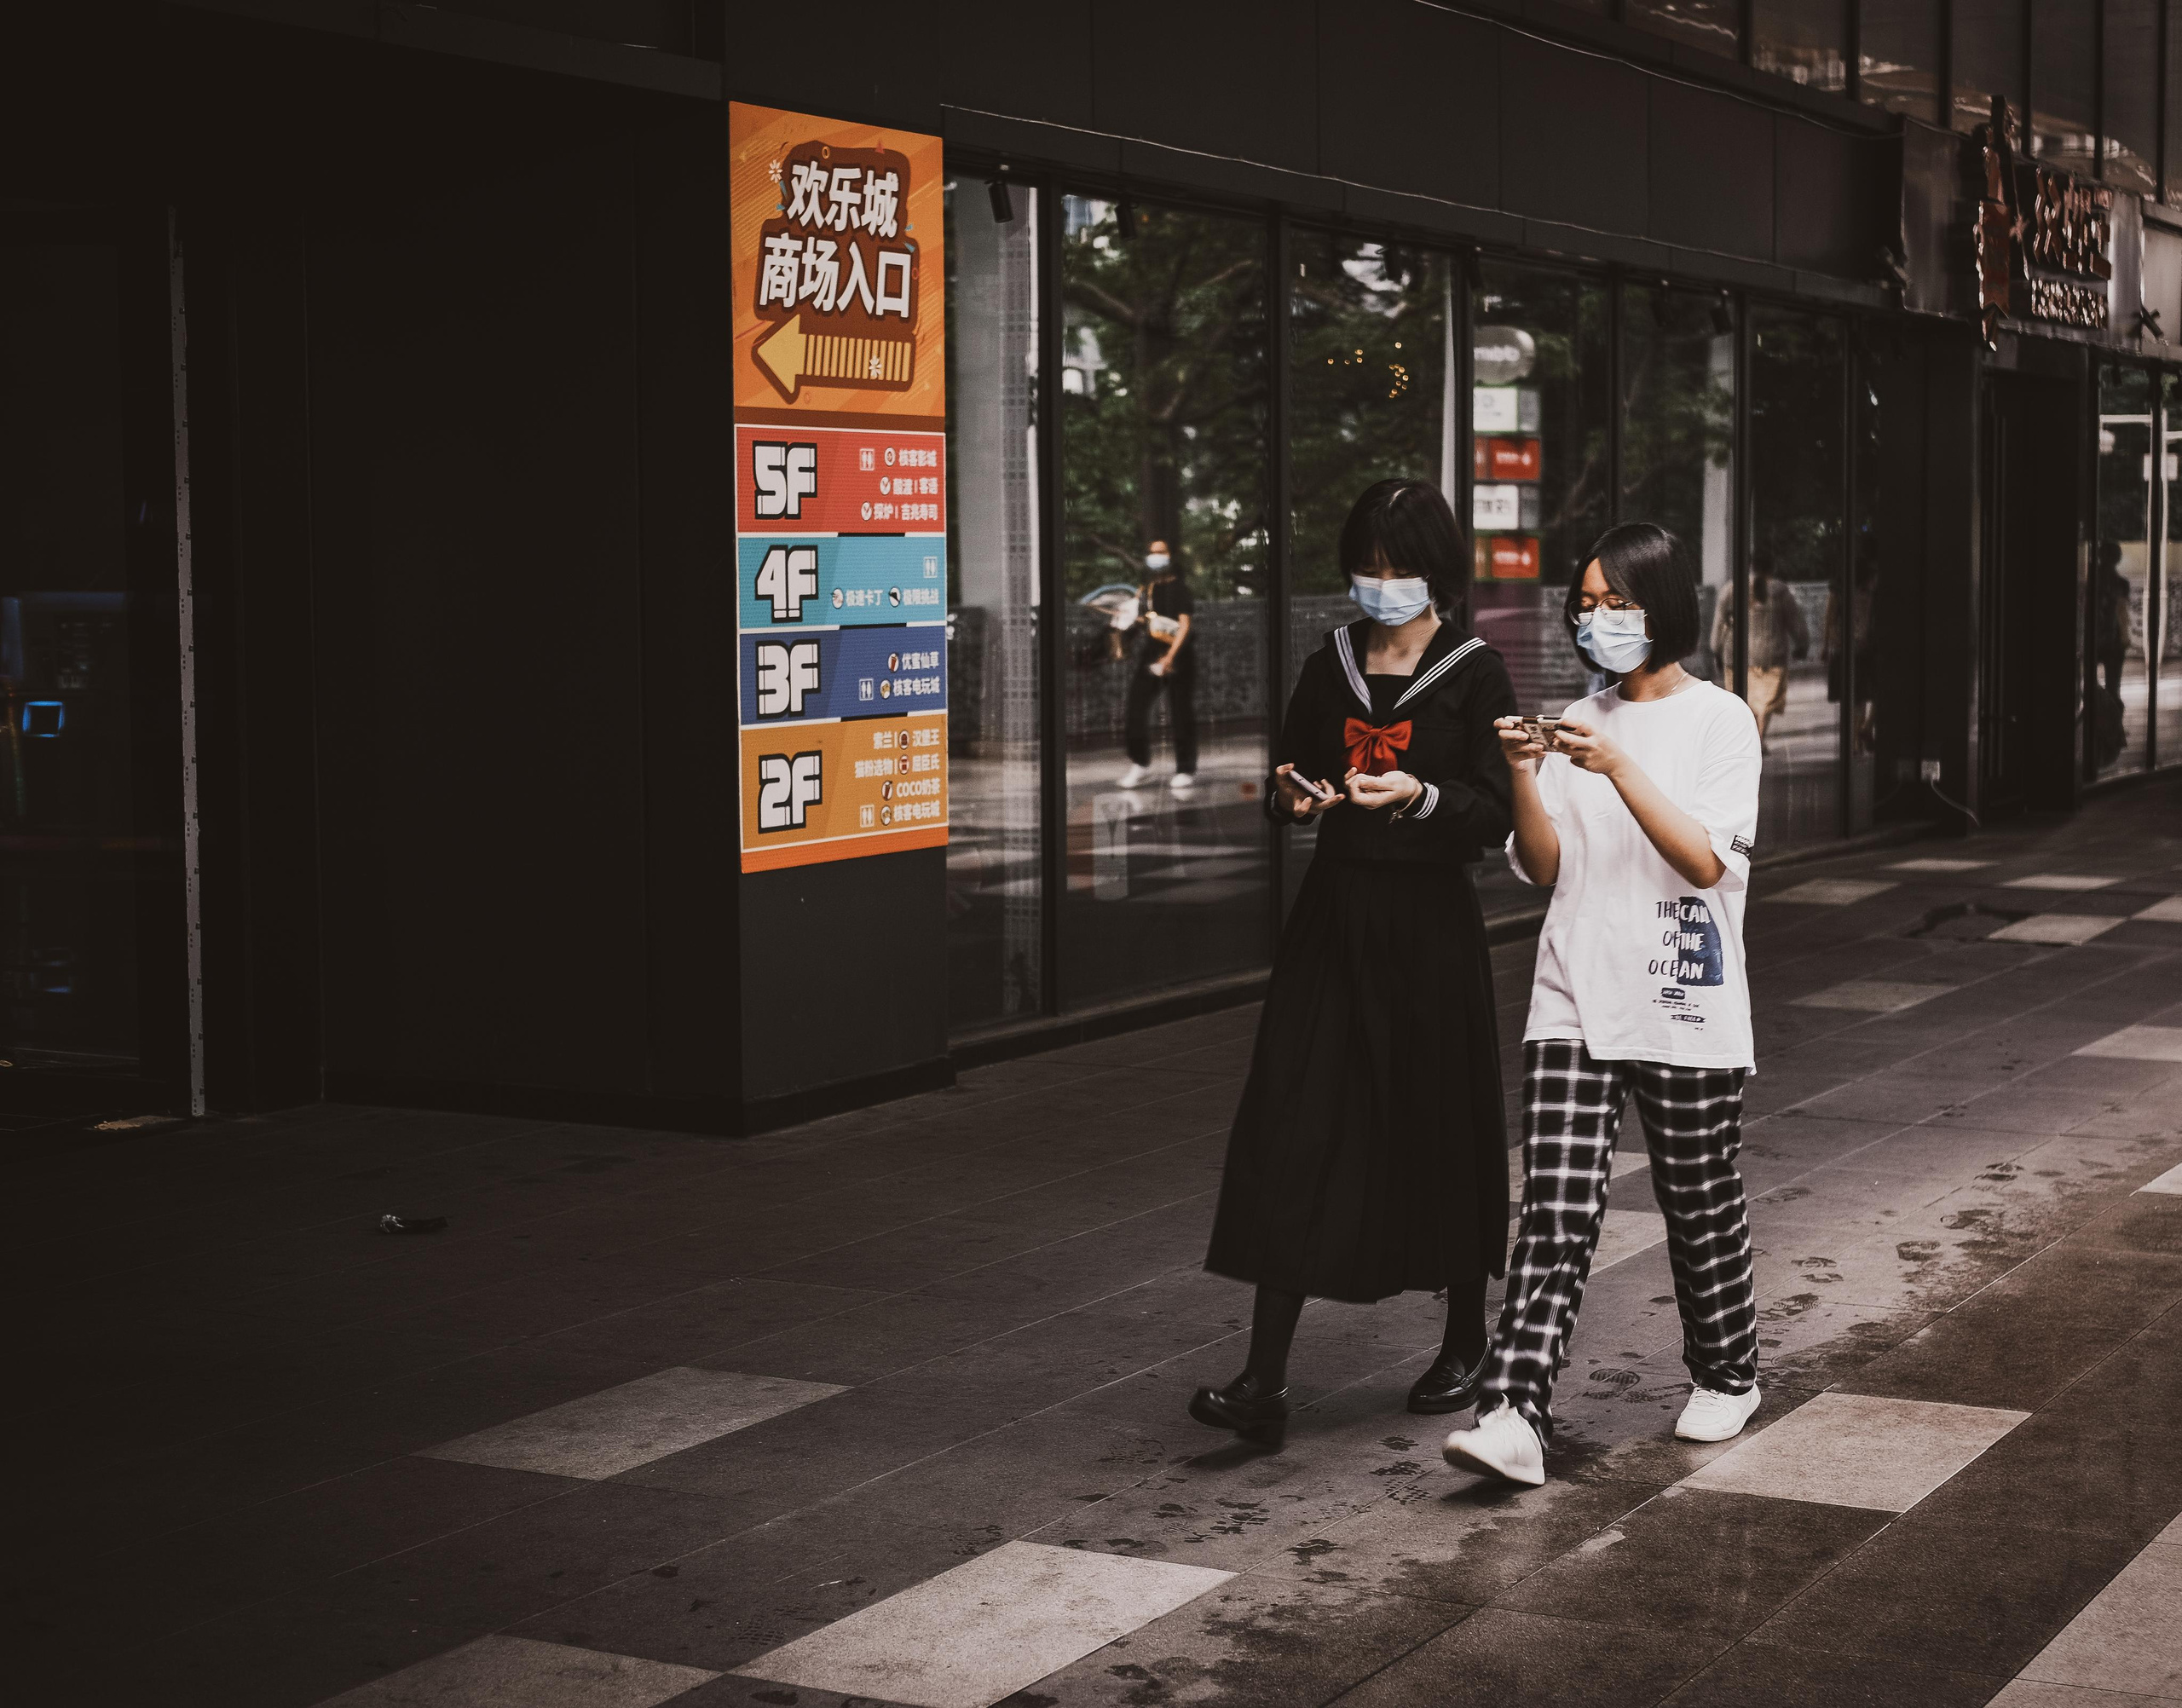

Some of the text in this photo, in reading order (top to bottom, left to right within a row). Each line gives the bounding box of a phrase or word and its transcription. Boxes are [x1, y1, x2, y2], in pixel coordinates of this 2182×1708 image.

[787, 161, 898, 238] 欢乐城
[759, 233, 911, 318] 商场入口
[754, 444, 816, 516] 5F
[756, 548, 817, 620] 4F
[758, 643, 818, 715] 3F
[759, 755, 820, 828] 2F
[1655, 901, 1680, 920] THE
[1663, 931, 1705, 951] OF THE
[1648, 959, 1704, 979] OCEAN
